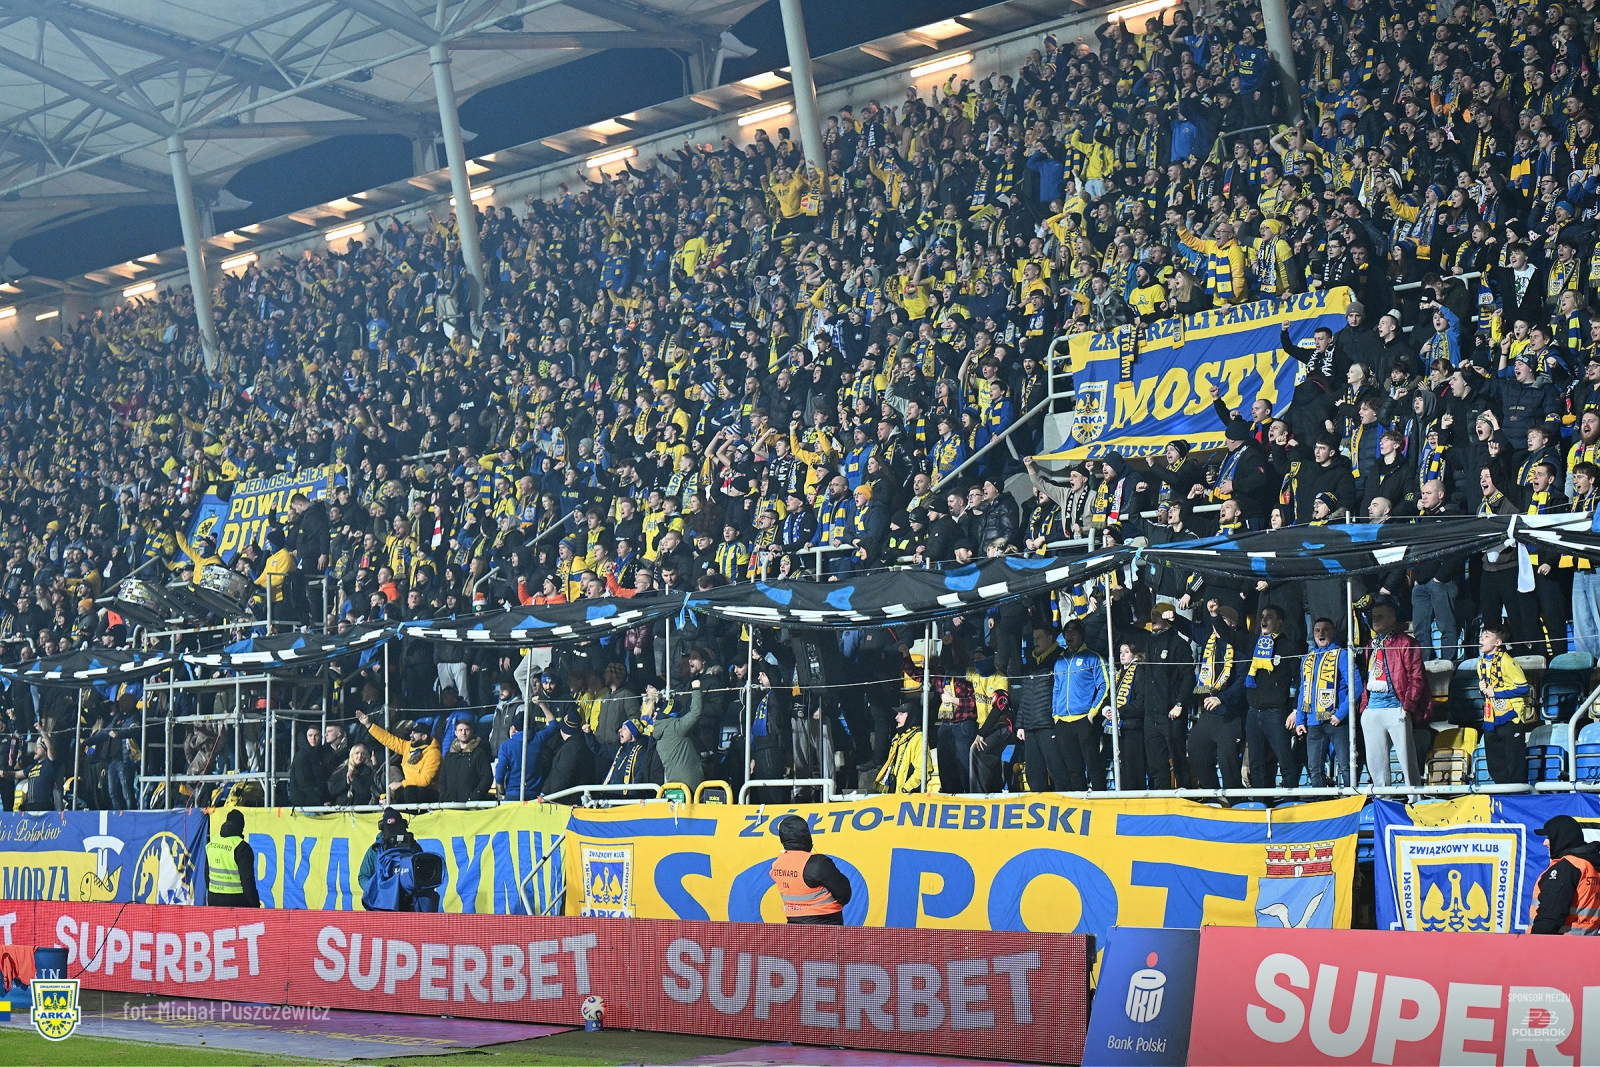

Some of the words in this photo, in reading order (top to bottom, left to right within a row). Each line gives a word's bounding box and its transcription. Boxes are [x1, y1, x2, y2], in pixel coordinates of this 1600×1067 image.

[1073, 415, 1103, 424] ARKA
[1108, 347, 1300, 431] MOSTY
[773, 869, 799, 878] STEWARD
[1409, 843, 1469, 857] ZWIĄZKOWY
[1472, 843, 1499, 853] KLUB
[654, 847, 1249, 935] SOPOT
[1403, 871, 1413, 919] MORSKI
[1496, 859, 1509, 928] SPORTOWY
[54, 922, 266, 984] SUPERBET
[313, 924, 597, 1004] SUPERBET
[662, 935, 1041, 1033] SUPERBET
[1107, 1034, 1134, 1051] Bank
[1135, 1037, 1167, 1054] Polski
